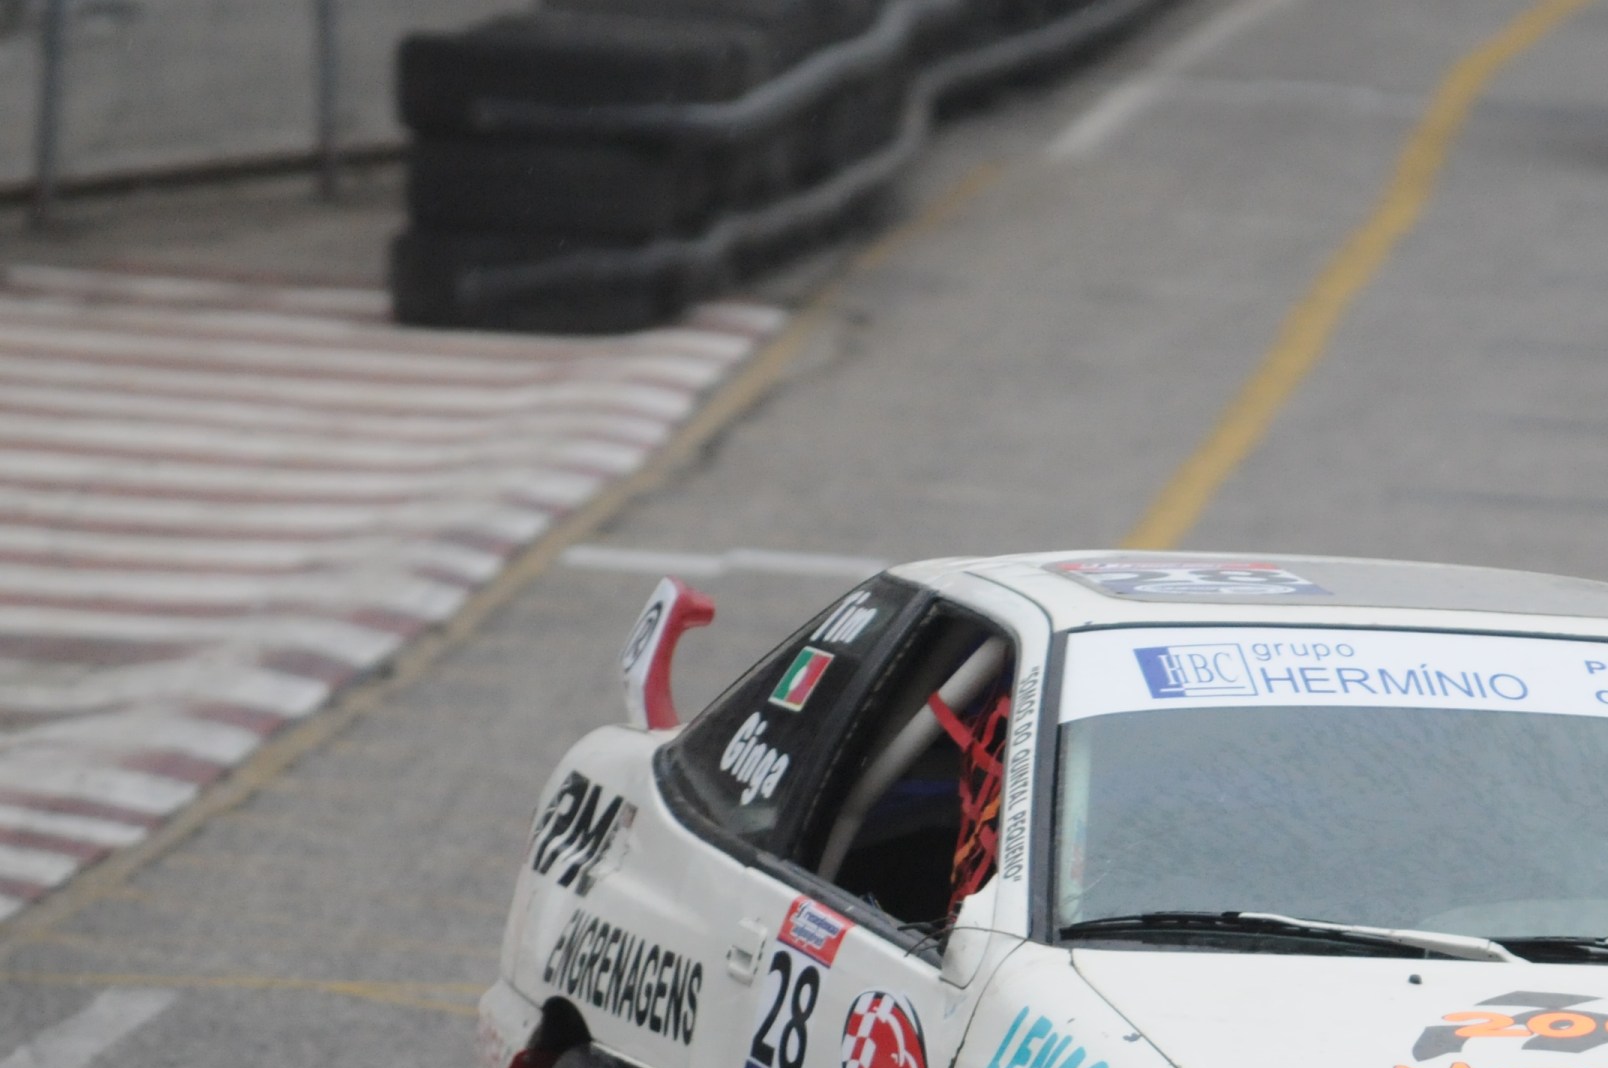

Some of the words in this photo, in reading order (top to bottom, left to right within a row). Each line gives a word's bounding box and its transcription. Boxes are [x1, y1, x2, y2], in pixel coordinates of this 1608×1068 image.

[1252, 643, 1355, 661] grupo
[1259, 663, 1529, 701] HERMÍNIO
[544, 909, 703, 1046] ENGRENAGENS
